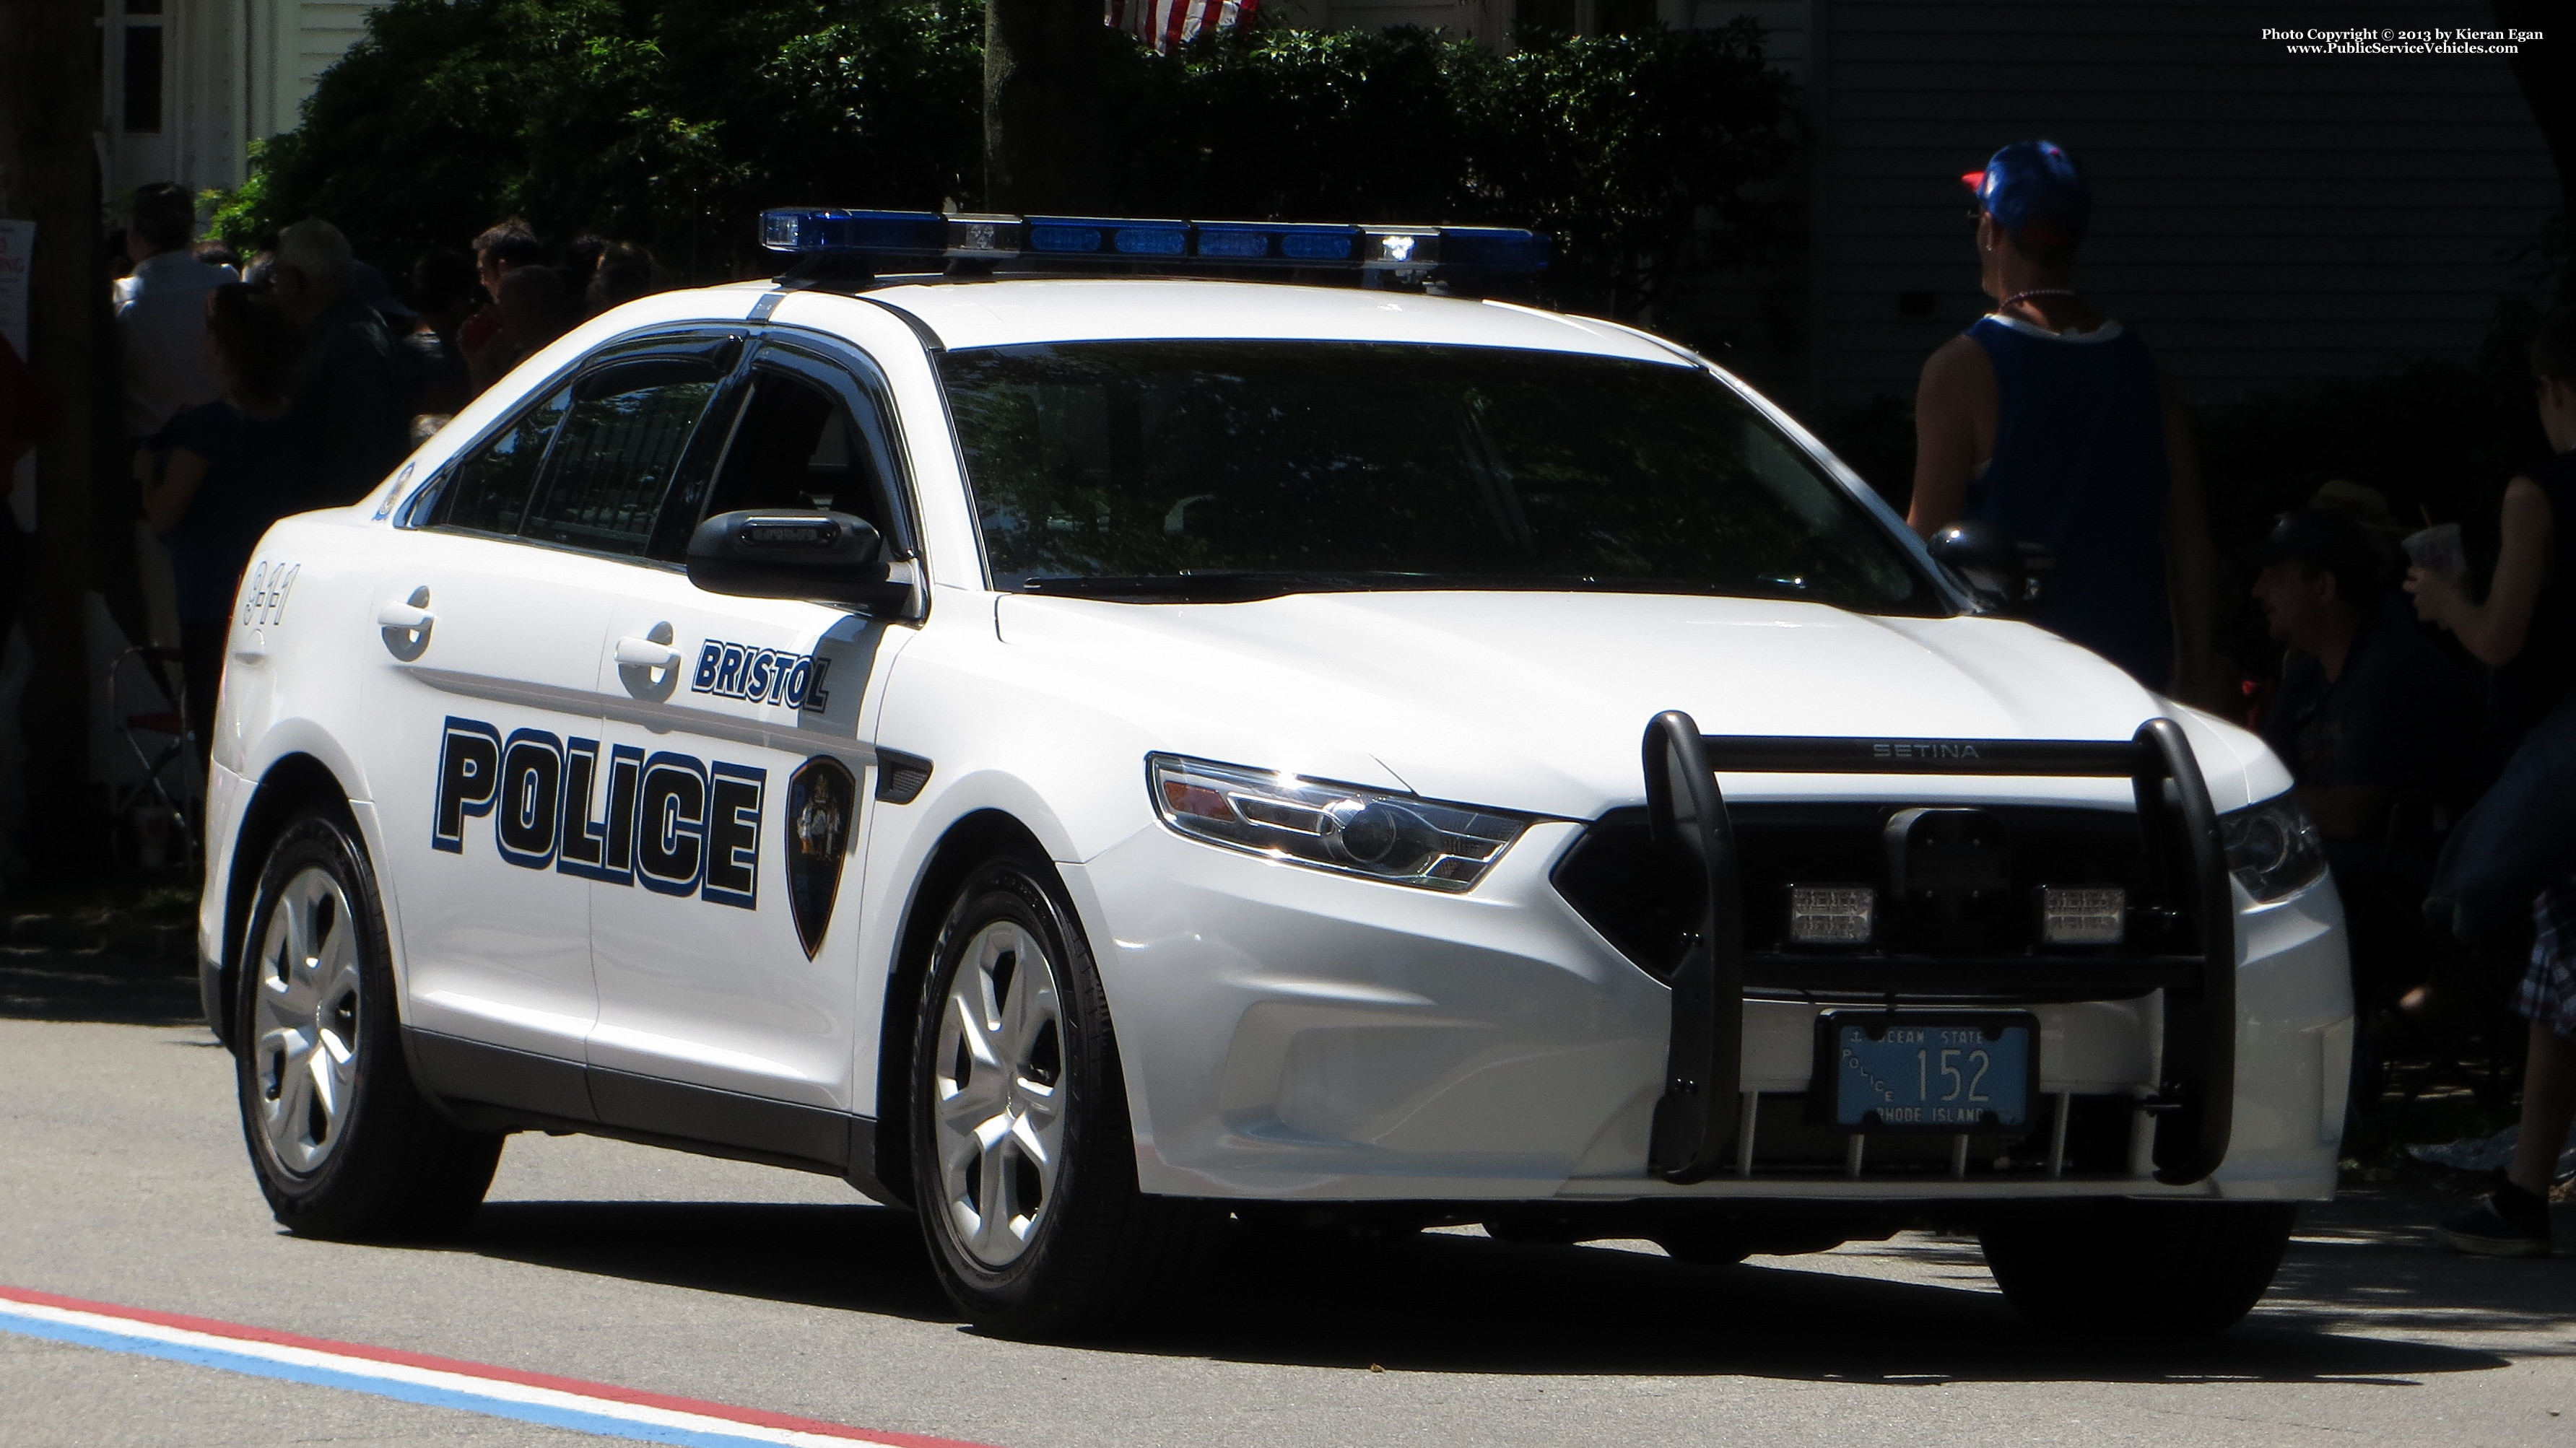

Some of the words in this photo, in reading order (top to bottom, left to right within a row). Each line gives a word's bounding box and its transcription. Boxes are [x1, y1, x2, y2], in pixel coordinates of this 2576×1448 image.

[244, 561, 300, 625] 9-1-1
[691, 638, 832, 713] BRISTOL
[1874, 743, 1979, 758] SETINA
[432, 715, 767, 911] POLICE
[1941, 1031, 1984, 1044] STATE
[1842, 1048, 1894, 1102] POLICE
[1918, 1049, 1990, 1102] 152
